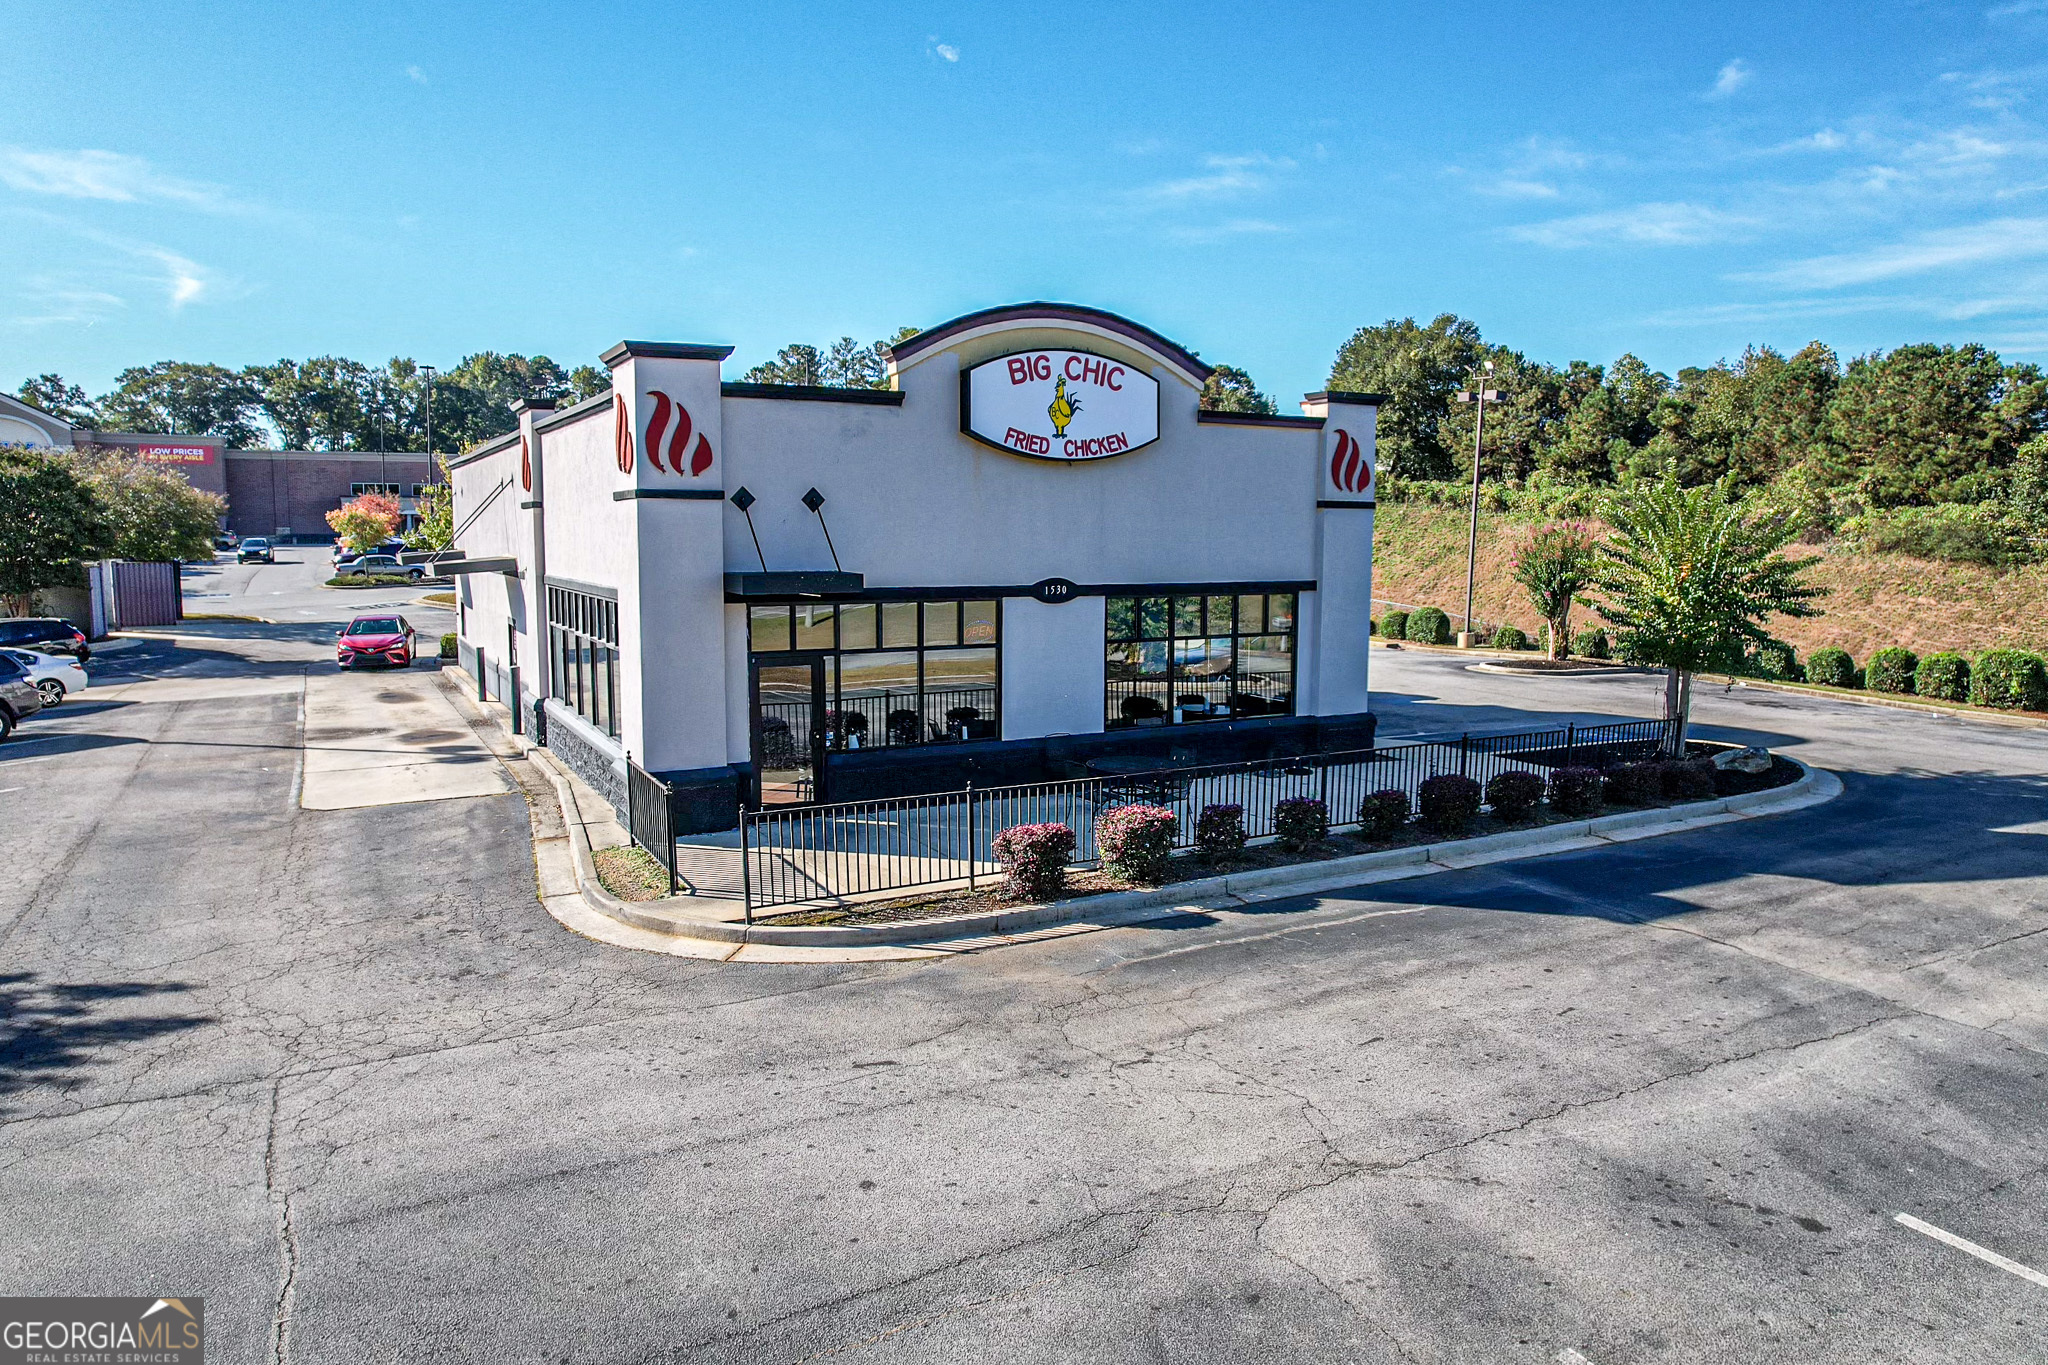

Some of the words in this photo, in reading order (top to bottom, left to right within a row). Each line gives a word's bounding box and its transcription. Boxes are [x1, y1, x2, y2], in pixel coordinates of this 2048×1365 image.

[1007, 355, 1051, 385] BIG
[1064, 356, 1125, 391] CHIC
[1004, 427, 1050, 455] FRIED
[1063, 432, 1128, 457] CHICKEN
[149, 447, 171, 455] LOW
[172, 448, 204, 456] PRICES
[1045, 585, 1067, 595] 1530
[964, 625, 994, 637] OPEN
